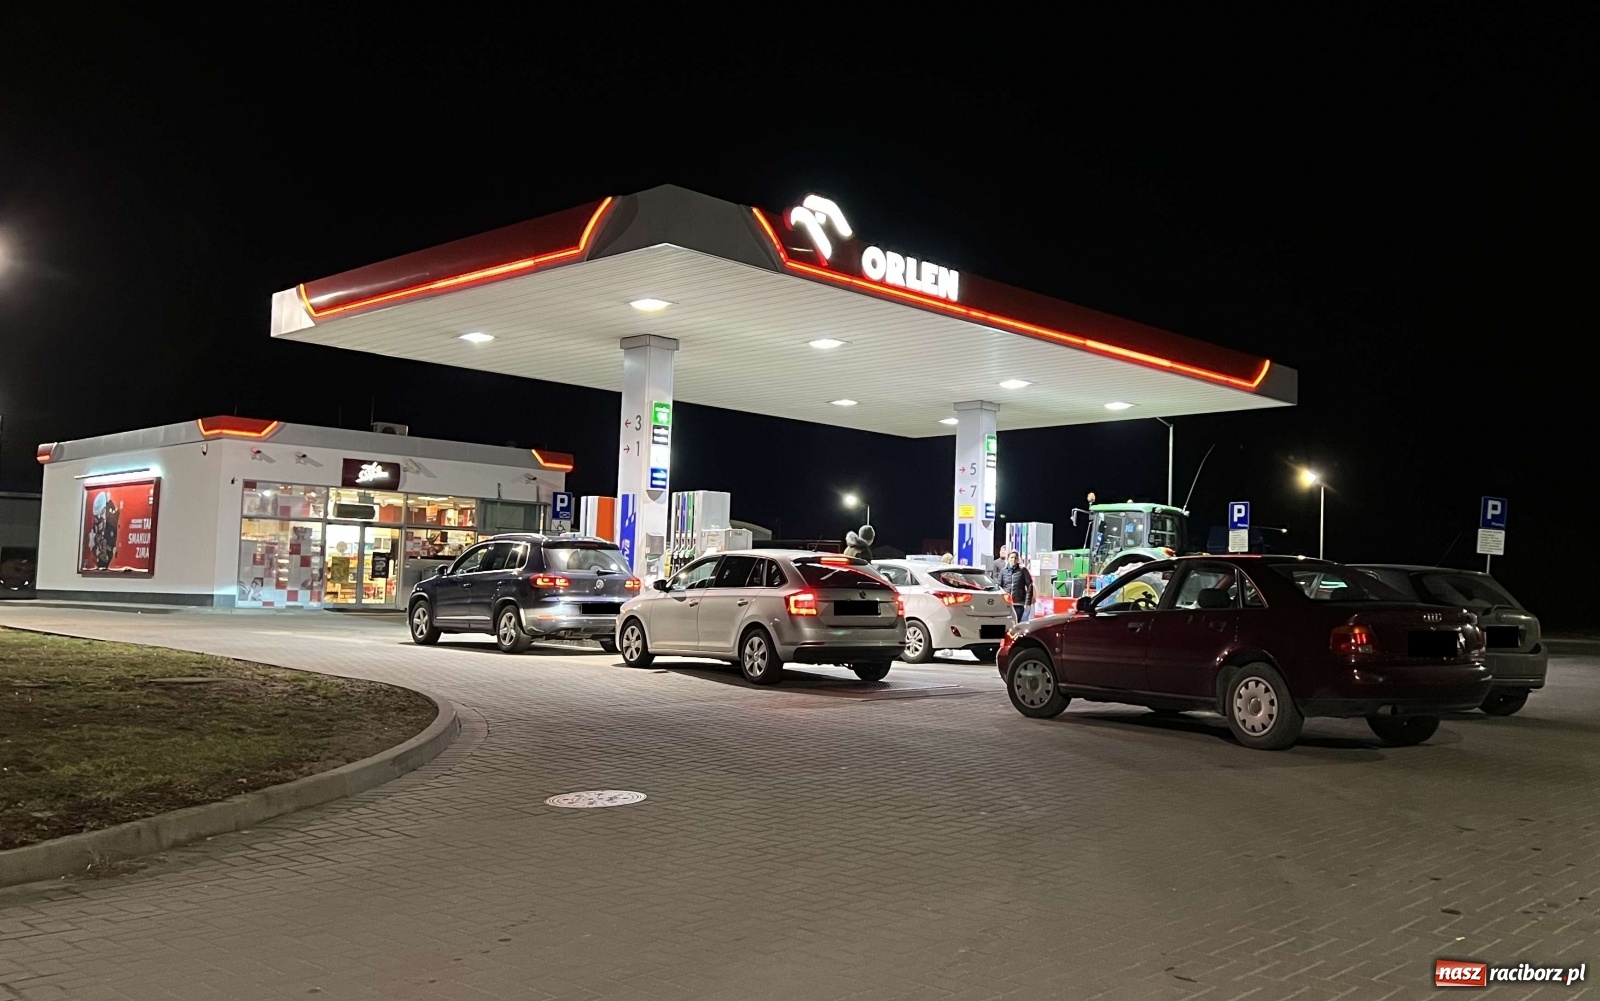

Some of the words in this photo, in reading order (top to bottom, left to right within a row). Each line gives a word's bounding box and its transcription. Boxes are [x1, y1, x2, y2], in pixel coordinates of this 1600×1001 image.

[861, 246, 959, 302] ORLEN
[634, 414, 641, 431] 3
[969, 462, 977, 475] 5
[970, 485, 977, 498] 7
[556, 494, 568, 512] P
[1487, 499, 1502, 519] P
[1233, 504, 1246, 522] P
